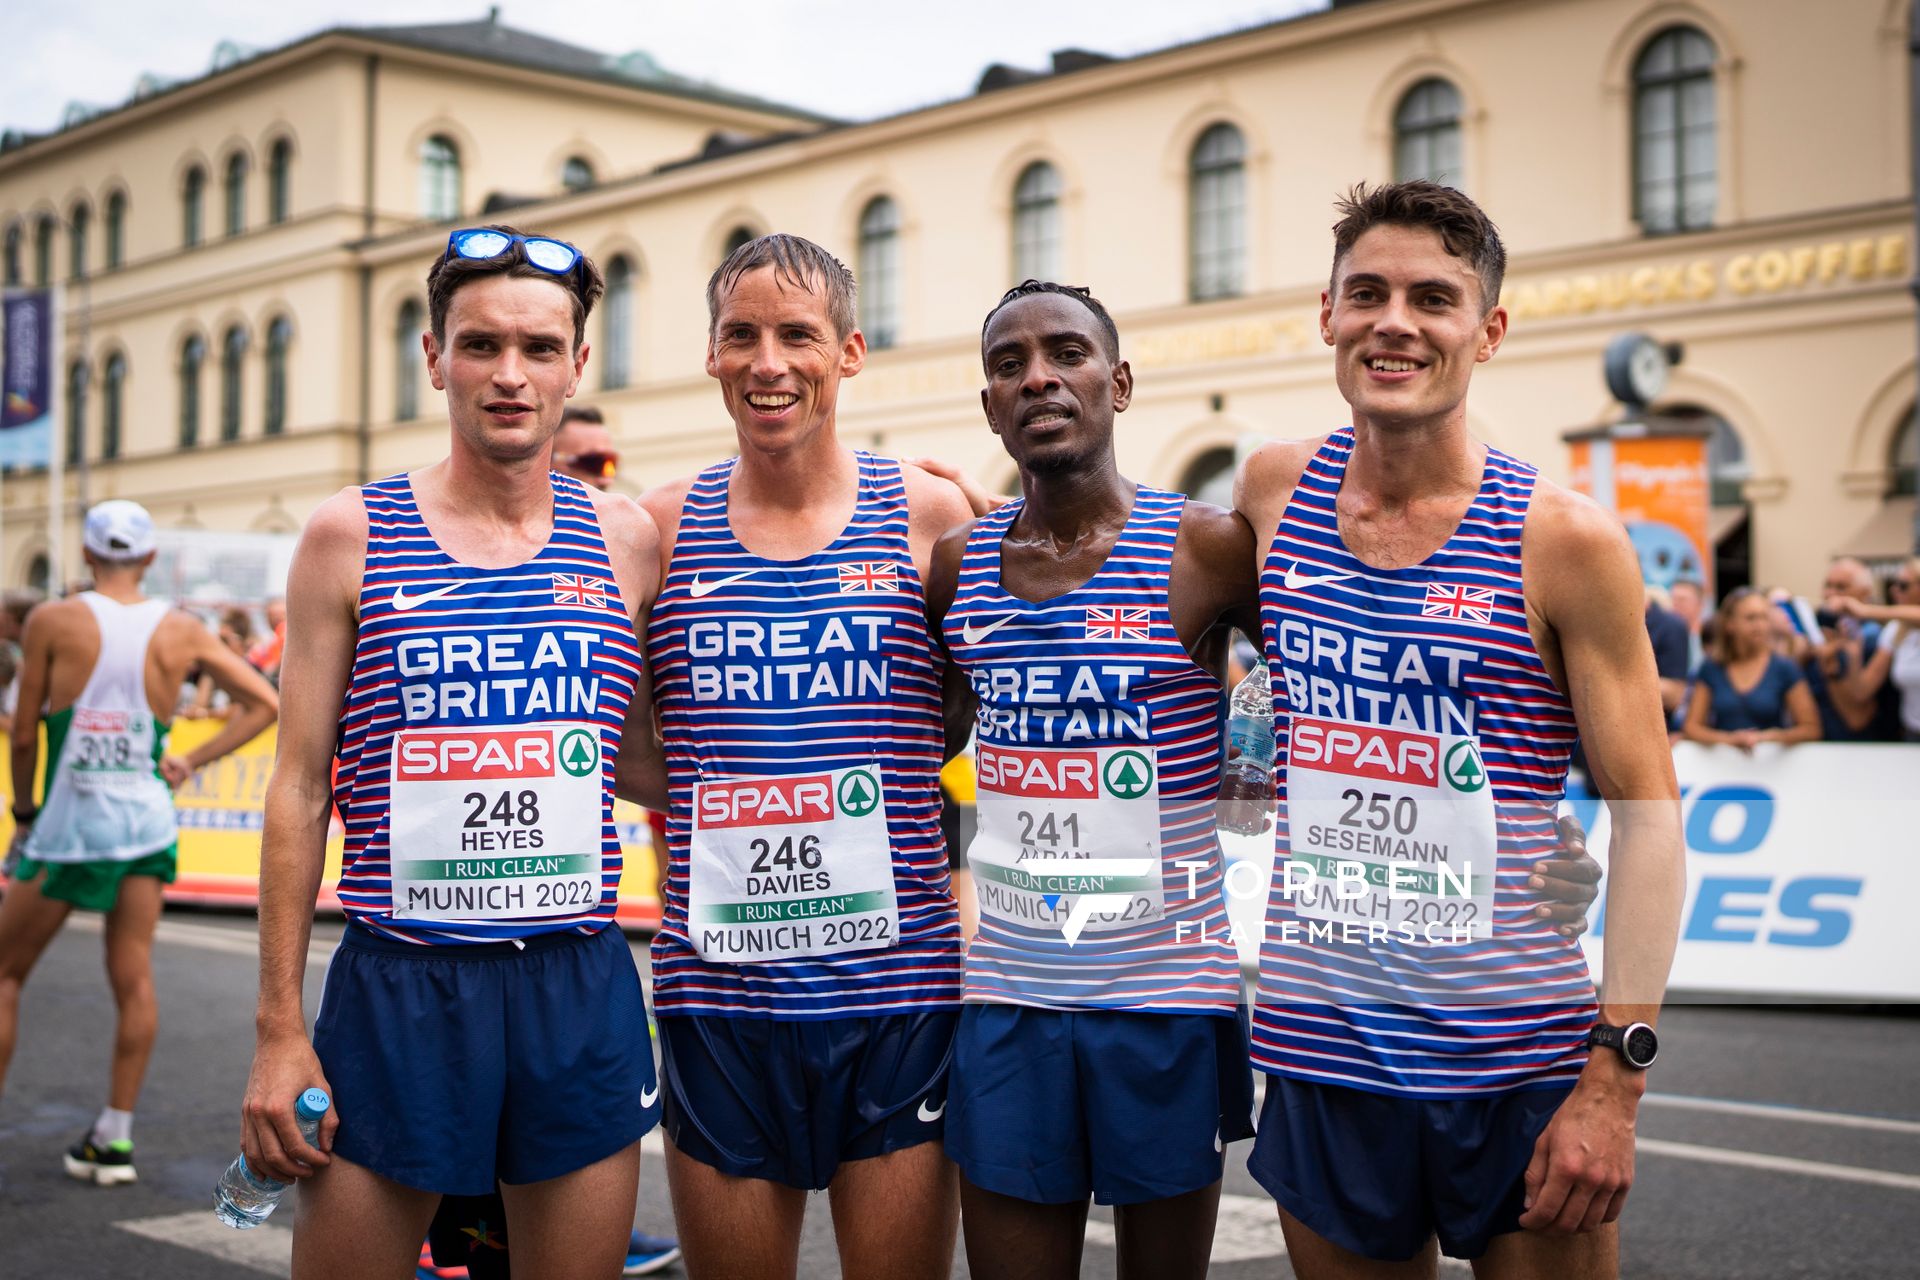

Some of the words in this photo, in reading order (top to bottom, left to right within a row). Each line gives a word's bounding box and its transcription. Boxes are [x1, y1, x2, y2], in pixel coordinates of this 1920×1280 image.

[1725, 233, 1906, 294] COFFEE
[397, 631, 601, 678] GREAT
[688, 616, 892, 658] GREAT
[1279, 619, 1479, 687] GREAT
[401, 676, 600, 721] BRITAIN
[690, 659, 889, 702] BRITAIN
[971, 665, 1145, 703] GREAT
[1282, 667, 1475, 736] BRITAIN
[976, 702, 1150, 743] BRITAIN
[401, 737, 551, 775] SPAR
[979, 751, 1094, 792] SPAR
[1292, 725, 1435, 779] SPAR
[463, 790, 540, 829] 248
[700, 783, 830, 823] SPAR
[1338, 788, 1418, 835] 250
[462, 829, 544, 851] HEYES
[1017, 810, 1080, 848] 241
[1307, 825, 1449, 864] SESEMANN
[445, 862, 449, 877] I
[456, 861, 496, 877] RUN
[749, 835, 823, 874] 246
[407, 884, 525, 911] MUNICH
[536, 880, 593, 908] 2022
[746, 871, 831, 896] DAVIES
[1011, 871, 1042, 891] RUN
[737, 906, 741, 920] I
[746, 904, 782, 920] RUN
[986, 884, 1070, 923] MUNICH
[1403, 899, 1478, 928] 2022
[703, 924, 812, 954] MUNICH
[822, 916, 890, 947] 2022
